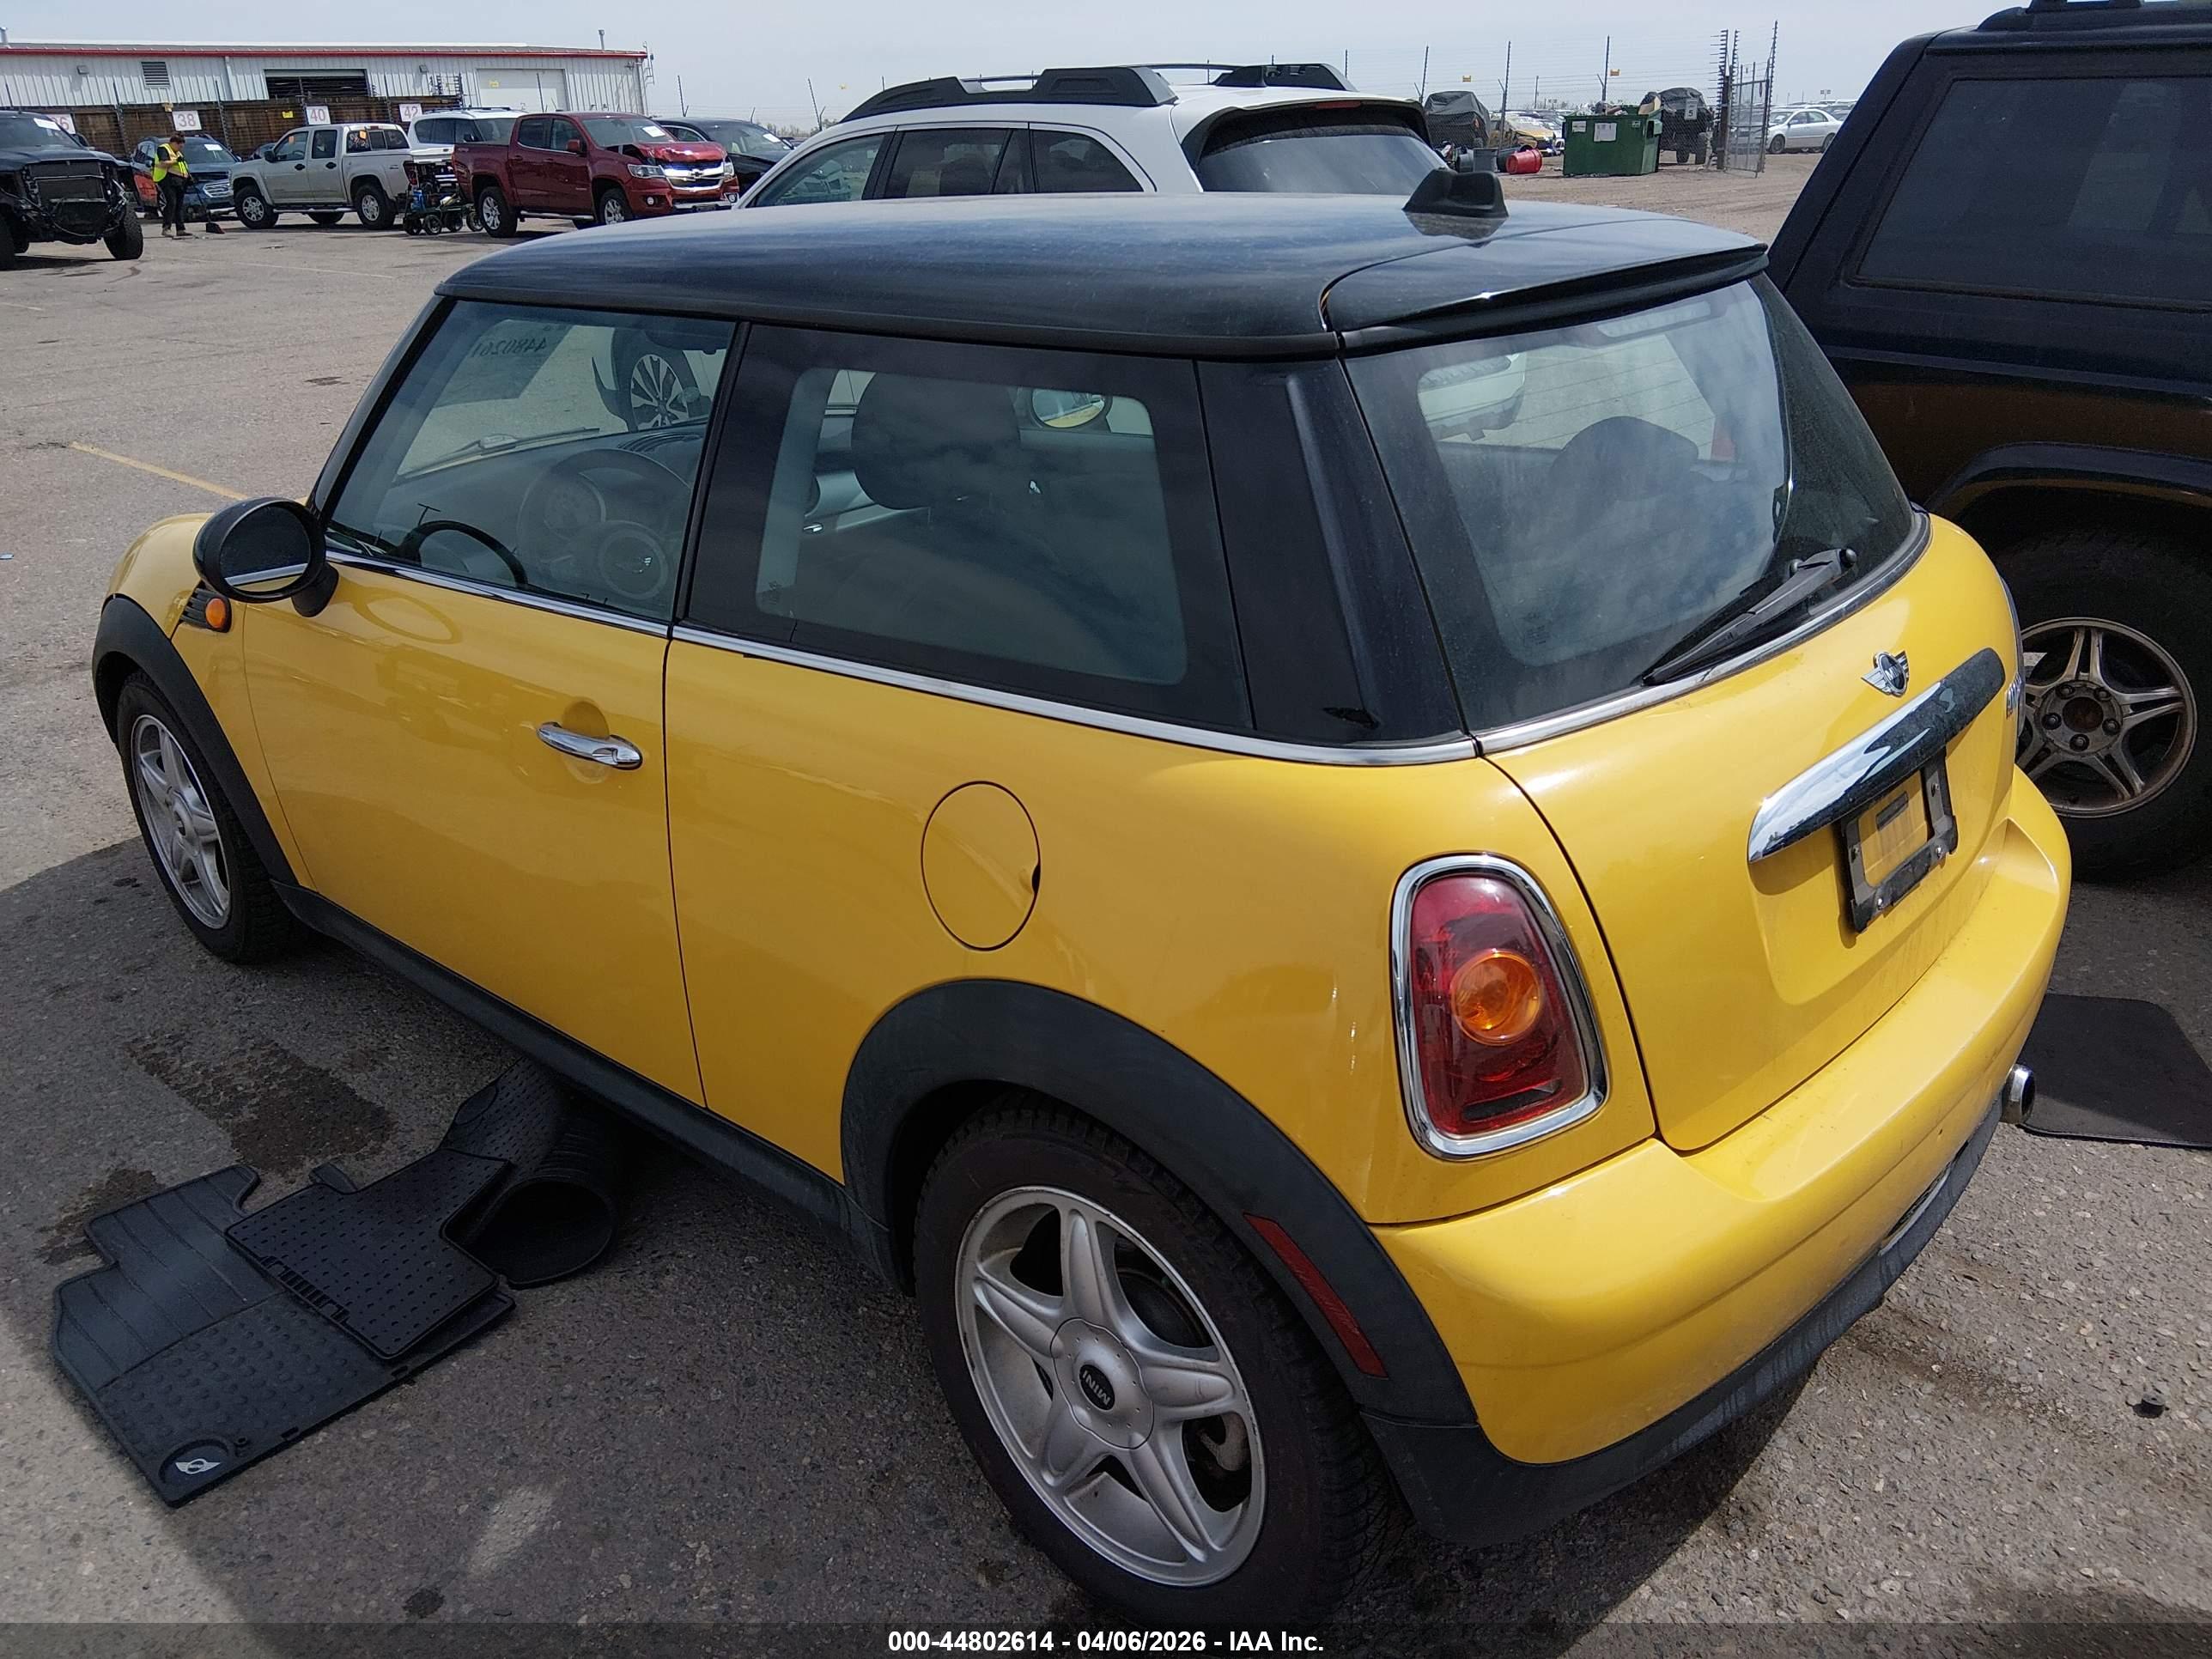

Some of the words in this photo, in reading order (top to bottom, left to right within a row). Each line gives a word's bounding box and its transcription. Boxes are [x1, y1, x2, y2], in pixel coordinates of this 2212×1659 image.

[310, 108, 326, 122] 40
[404, 106, 418, 119] 42
[177, 113, 196, 128] 38
[1082, 1370, 1110, 1405] MINI
